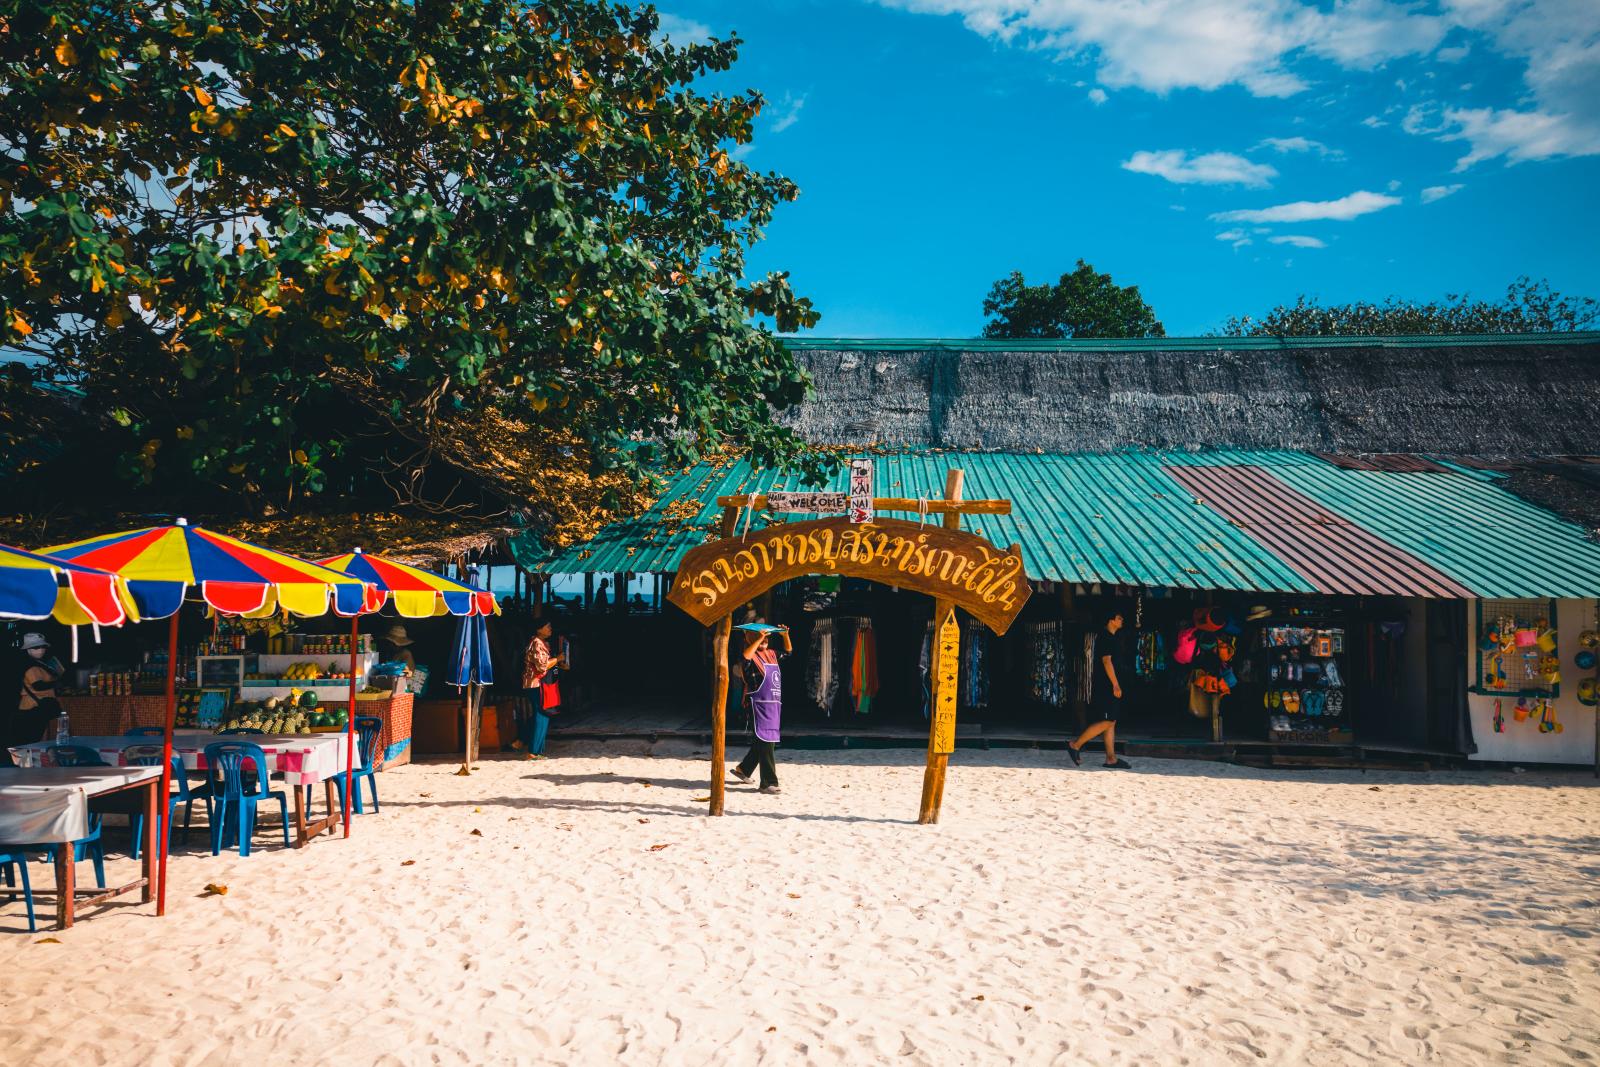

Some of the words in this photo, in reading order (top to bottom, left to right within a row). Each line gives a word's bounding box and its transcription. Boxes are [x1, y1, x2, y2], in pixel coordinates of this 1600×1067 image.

[852, 482, 870, 496] KAI
[789, 496, 844, 508] WELCOME
[852, 498, 869, 509] NAI
